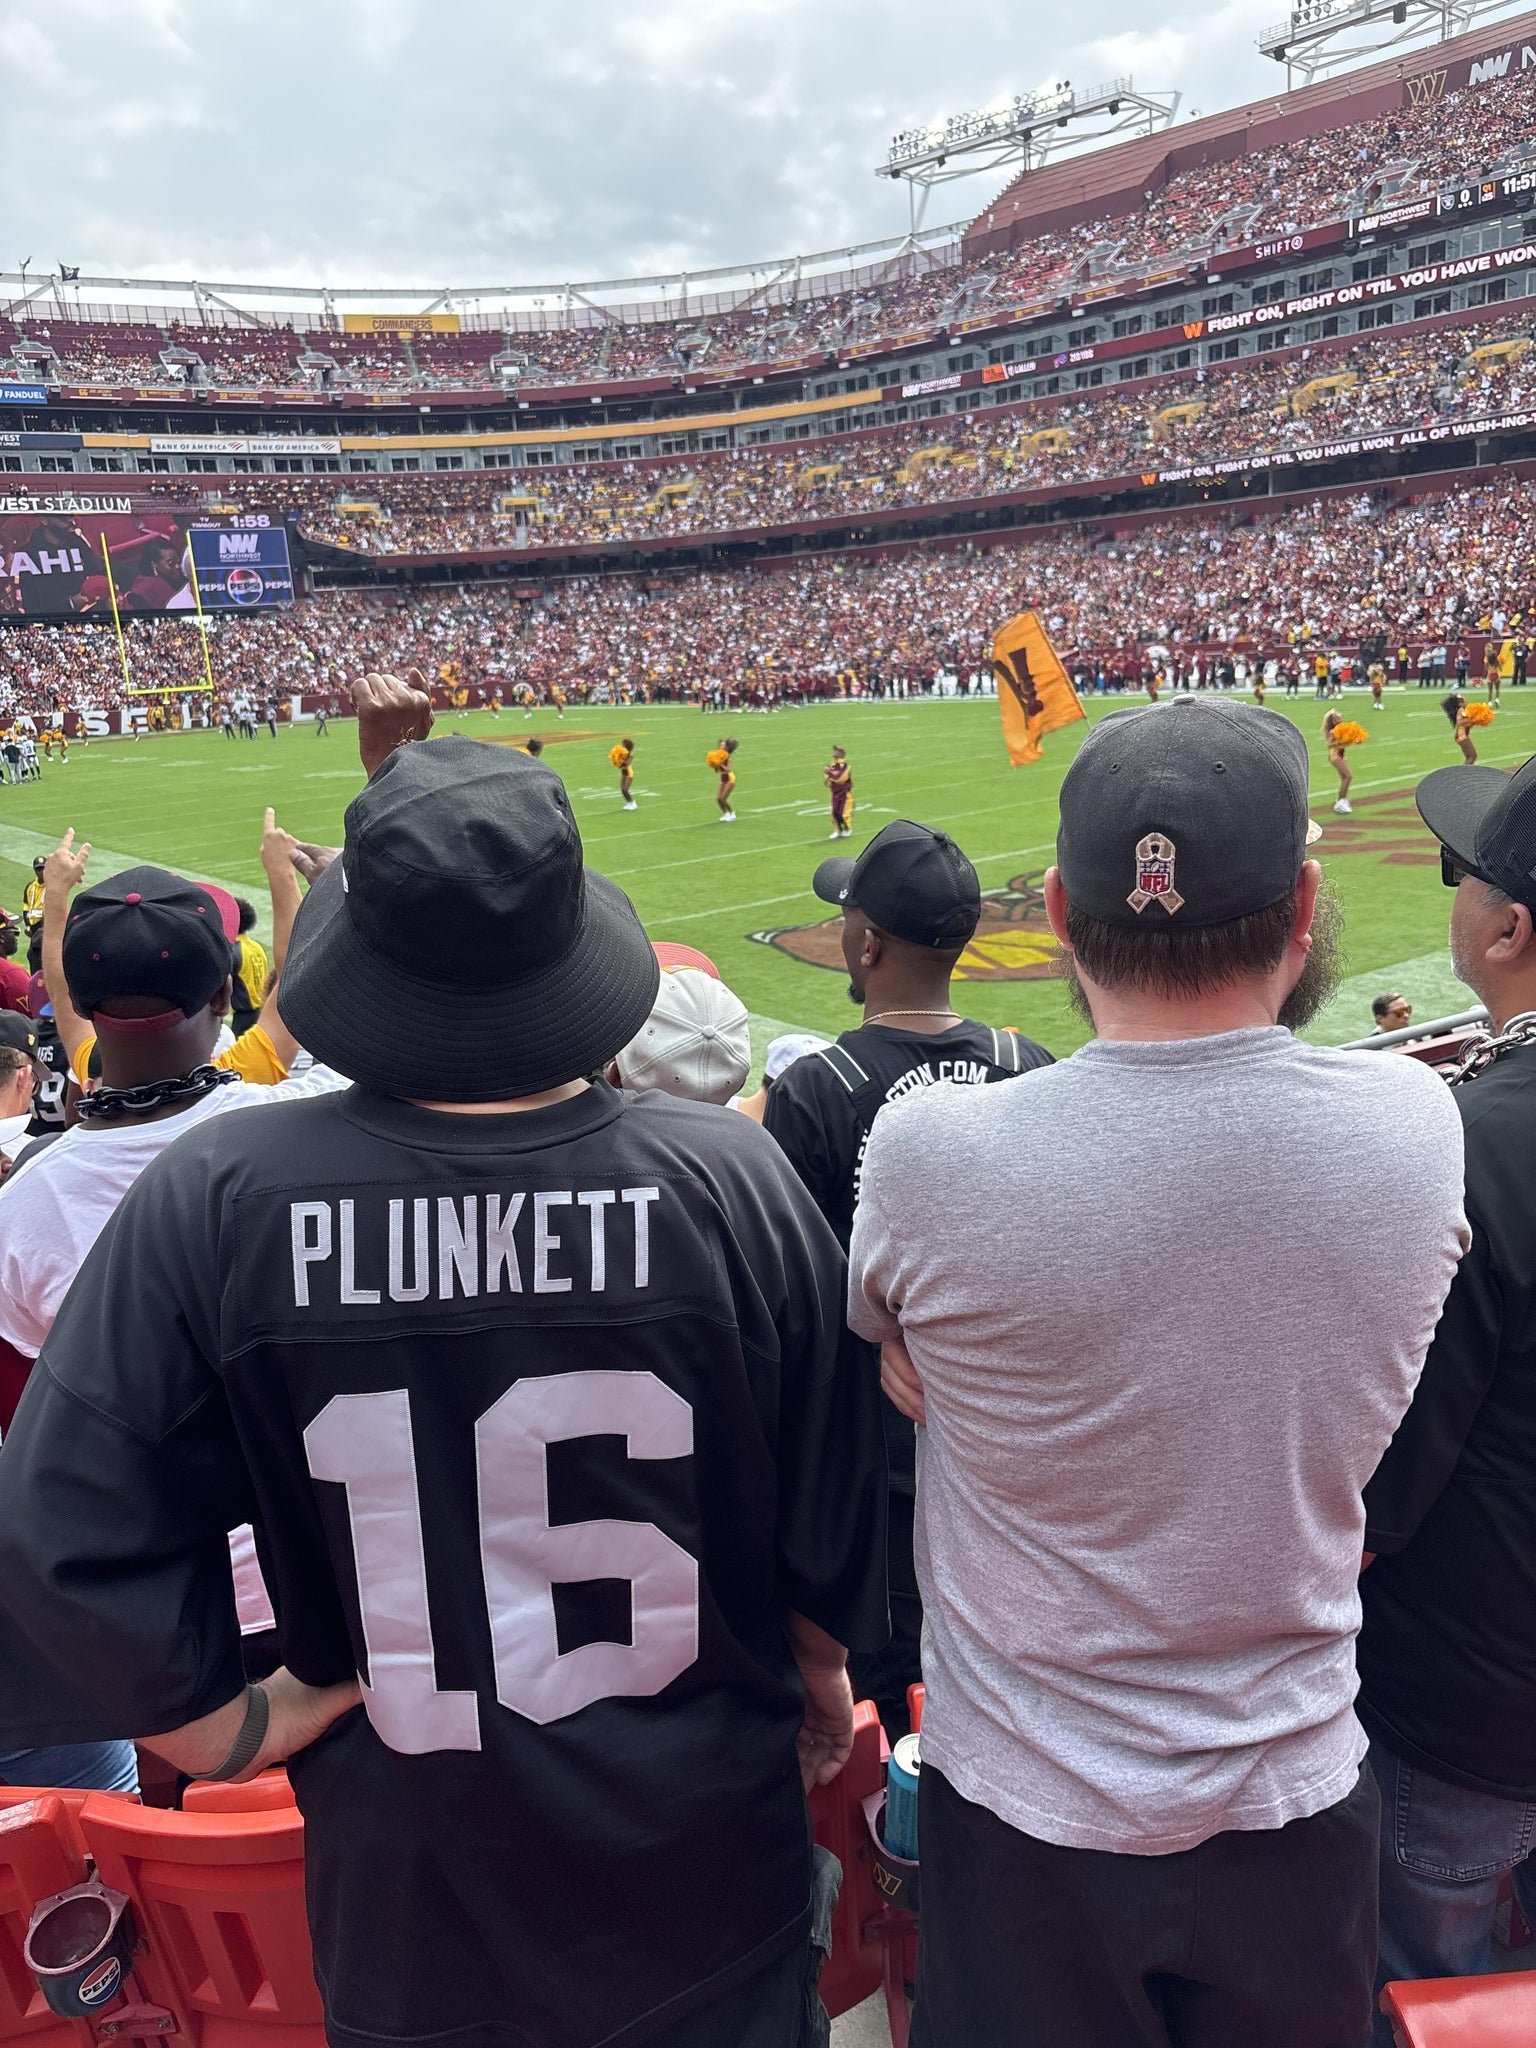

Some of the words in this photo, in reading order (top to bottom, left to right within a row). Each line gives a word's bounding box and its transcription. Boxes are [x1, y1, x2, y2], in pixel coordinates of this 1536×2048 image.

[1379, 202, 1431, 221] NORTHWEST
[1207, 311, 1254, 333] FIGHT
[1255, 305, 1284, 320] ON,
[1287, 291, 1336, 315] FIGHT
[1337, 285, 1363, 302] ON
[1400, 269, 1437, 289] YOU
[1440, 255, 1491, 280] HAVE
[1494, 246, 1536, 267] WON
[372, 319, 433, 330] COMMANDERS
[4, 390, 46, 399] FANDUEL
[192, 442, 227, 451] AMERICA
[286, 444, 320, 452] AMERICA
[1159, 467, 1192, 483] FIGHT
[1193, 465, 1214, 478] ON,
[1215, 458, 1250, 474] FIGHT
[1250, 455, 1270, 469] ON
[1297, 447, 1323, 461] YOU
[1325, 441, 1360, 456] HAVE
[1361, 436, 1395, 451] WON
[1400, 431, 1427, 445] ALL
[1429, 426, 1450, 440] OF
[44, 497, 131, 511] STADIUM
[229, 514, 271, 528] 1:58
[219, 552, 261, 560] NORTHWEST
[199, 583, 226, 592] PEPSI
[265, 580, 292, 590] PEPSI
[1141, 874, 1169, 894] NFL
[290, 1187, 660, 1307] PLUNKETT
[302, 1369, 699, 1756] 16
[81, 1962, 119, 1998] PEPSI
